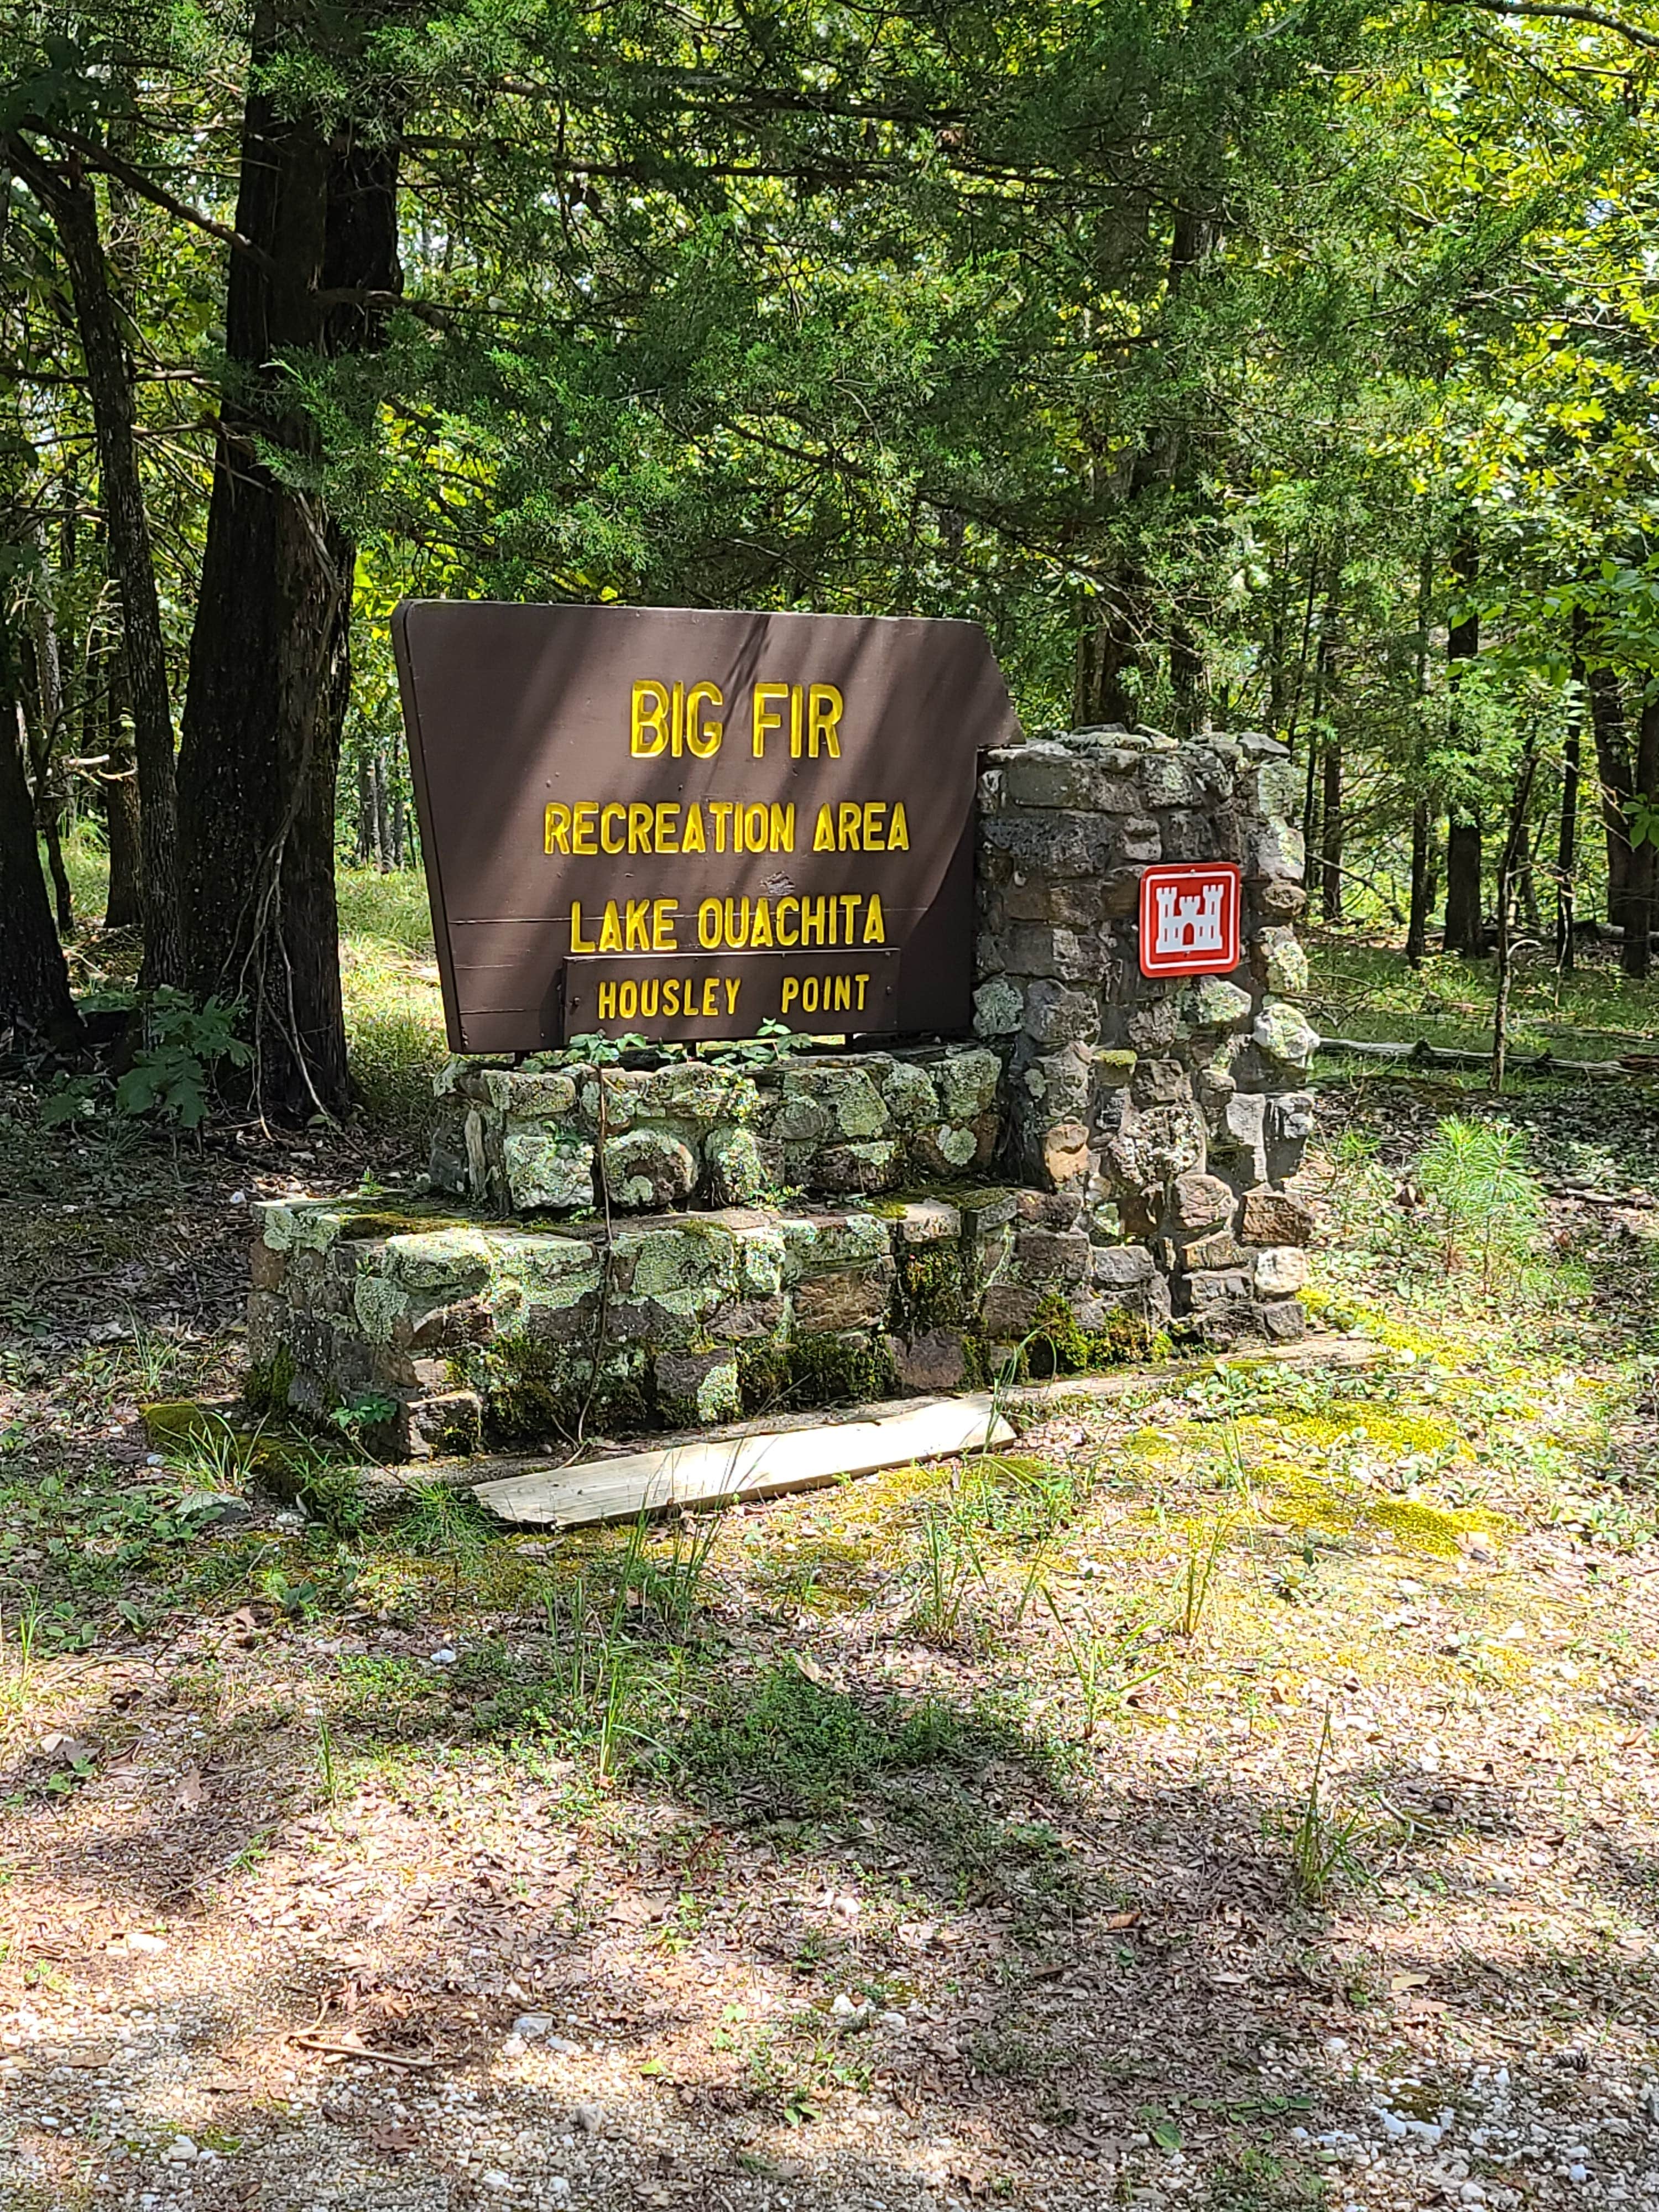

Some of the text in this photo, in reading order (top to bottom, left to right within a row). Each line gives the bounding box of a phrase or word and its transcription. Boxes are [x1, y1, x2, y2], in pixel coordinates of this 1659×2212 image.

[630, 680, 843, 760] BIG FIR
[544, 801, 909, 855] RECREATION AREA
[571, 894, 885, 953] LAKE OUACHITA
[599, 974, 869, 1019] HOUSLEY POINT
